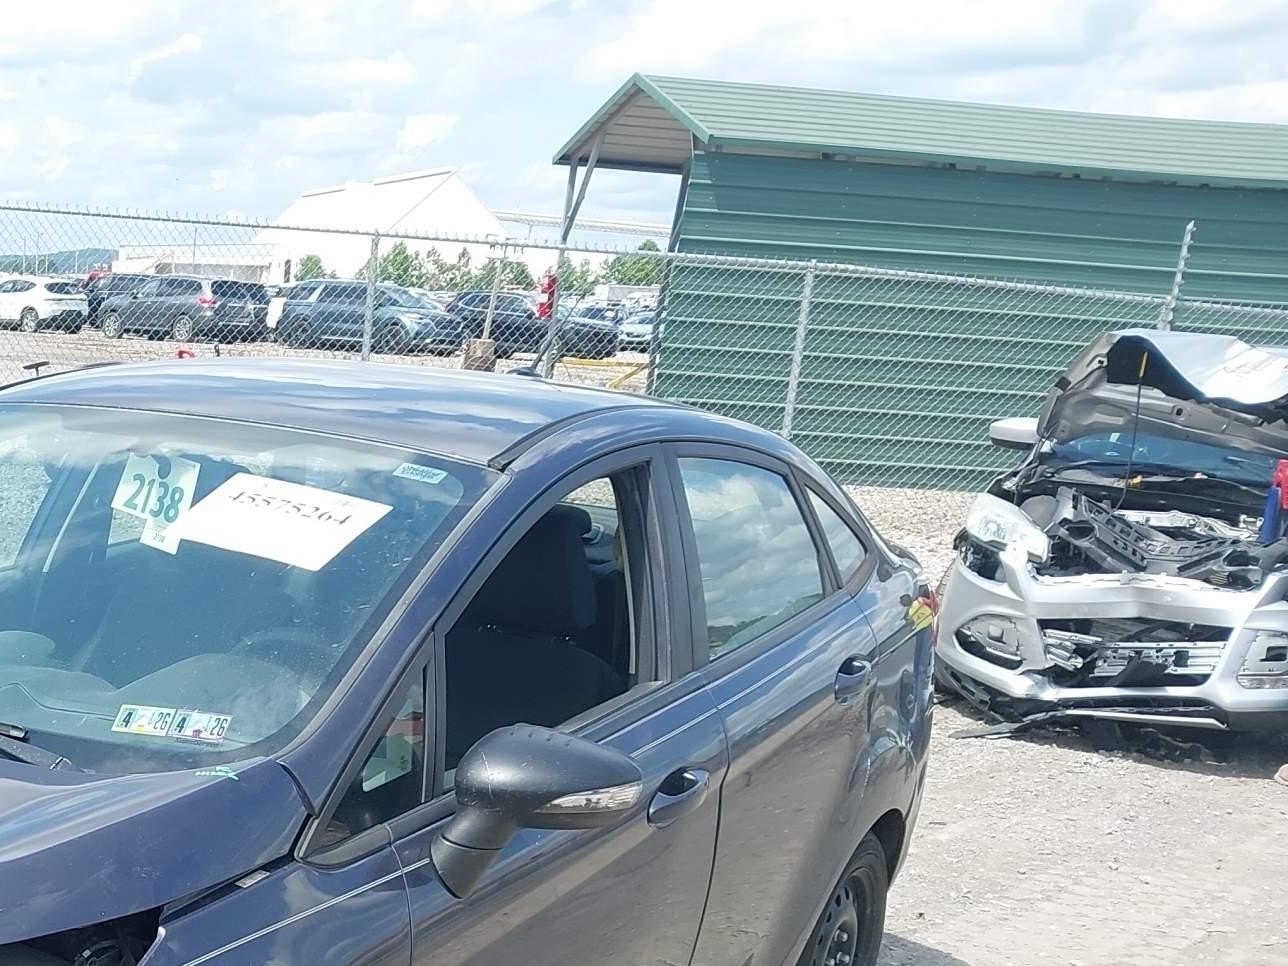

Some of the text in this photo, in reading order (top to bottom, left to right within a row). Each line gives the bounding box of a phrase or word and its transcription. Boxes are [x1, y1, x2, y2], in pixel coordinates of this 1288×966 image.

[123, 472, 185, 524] 2138
[120, 711, 171, 731] 4 26
[174, 716, 228, 737] 4 26
